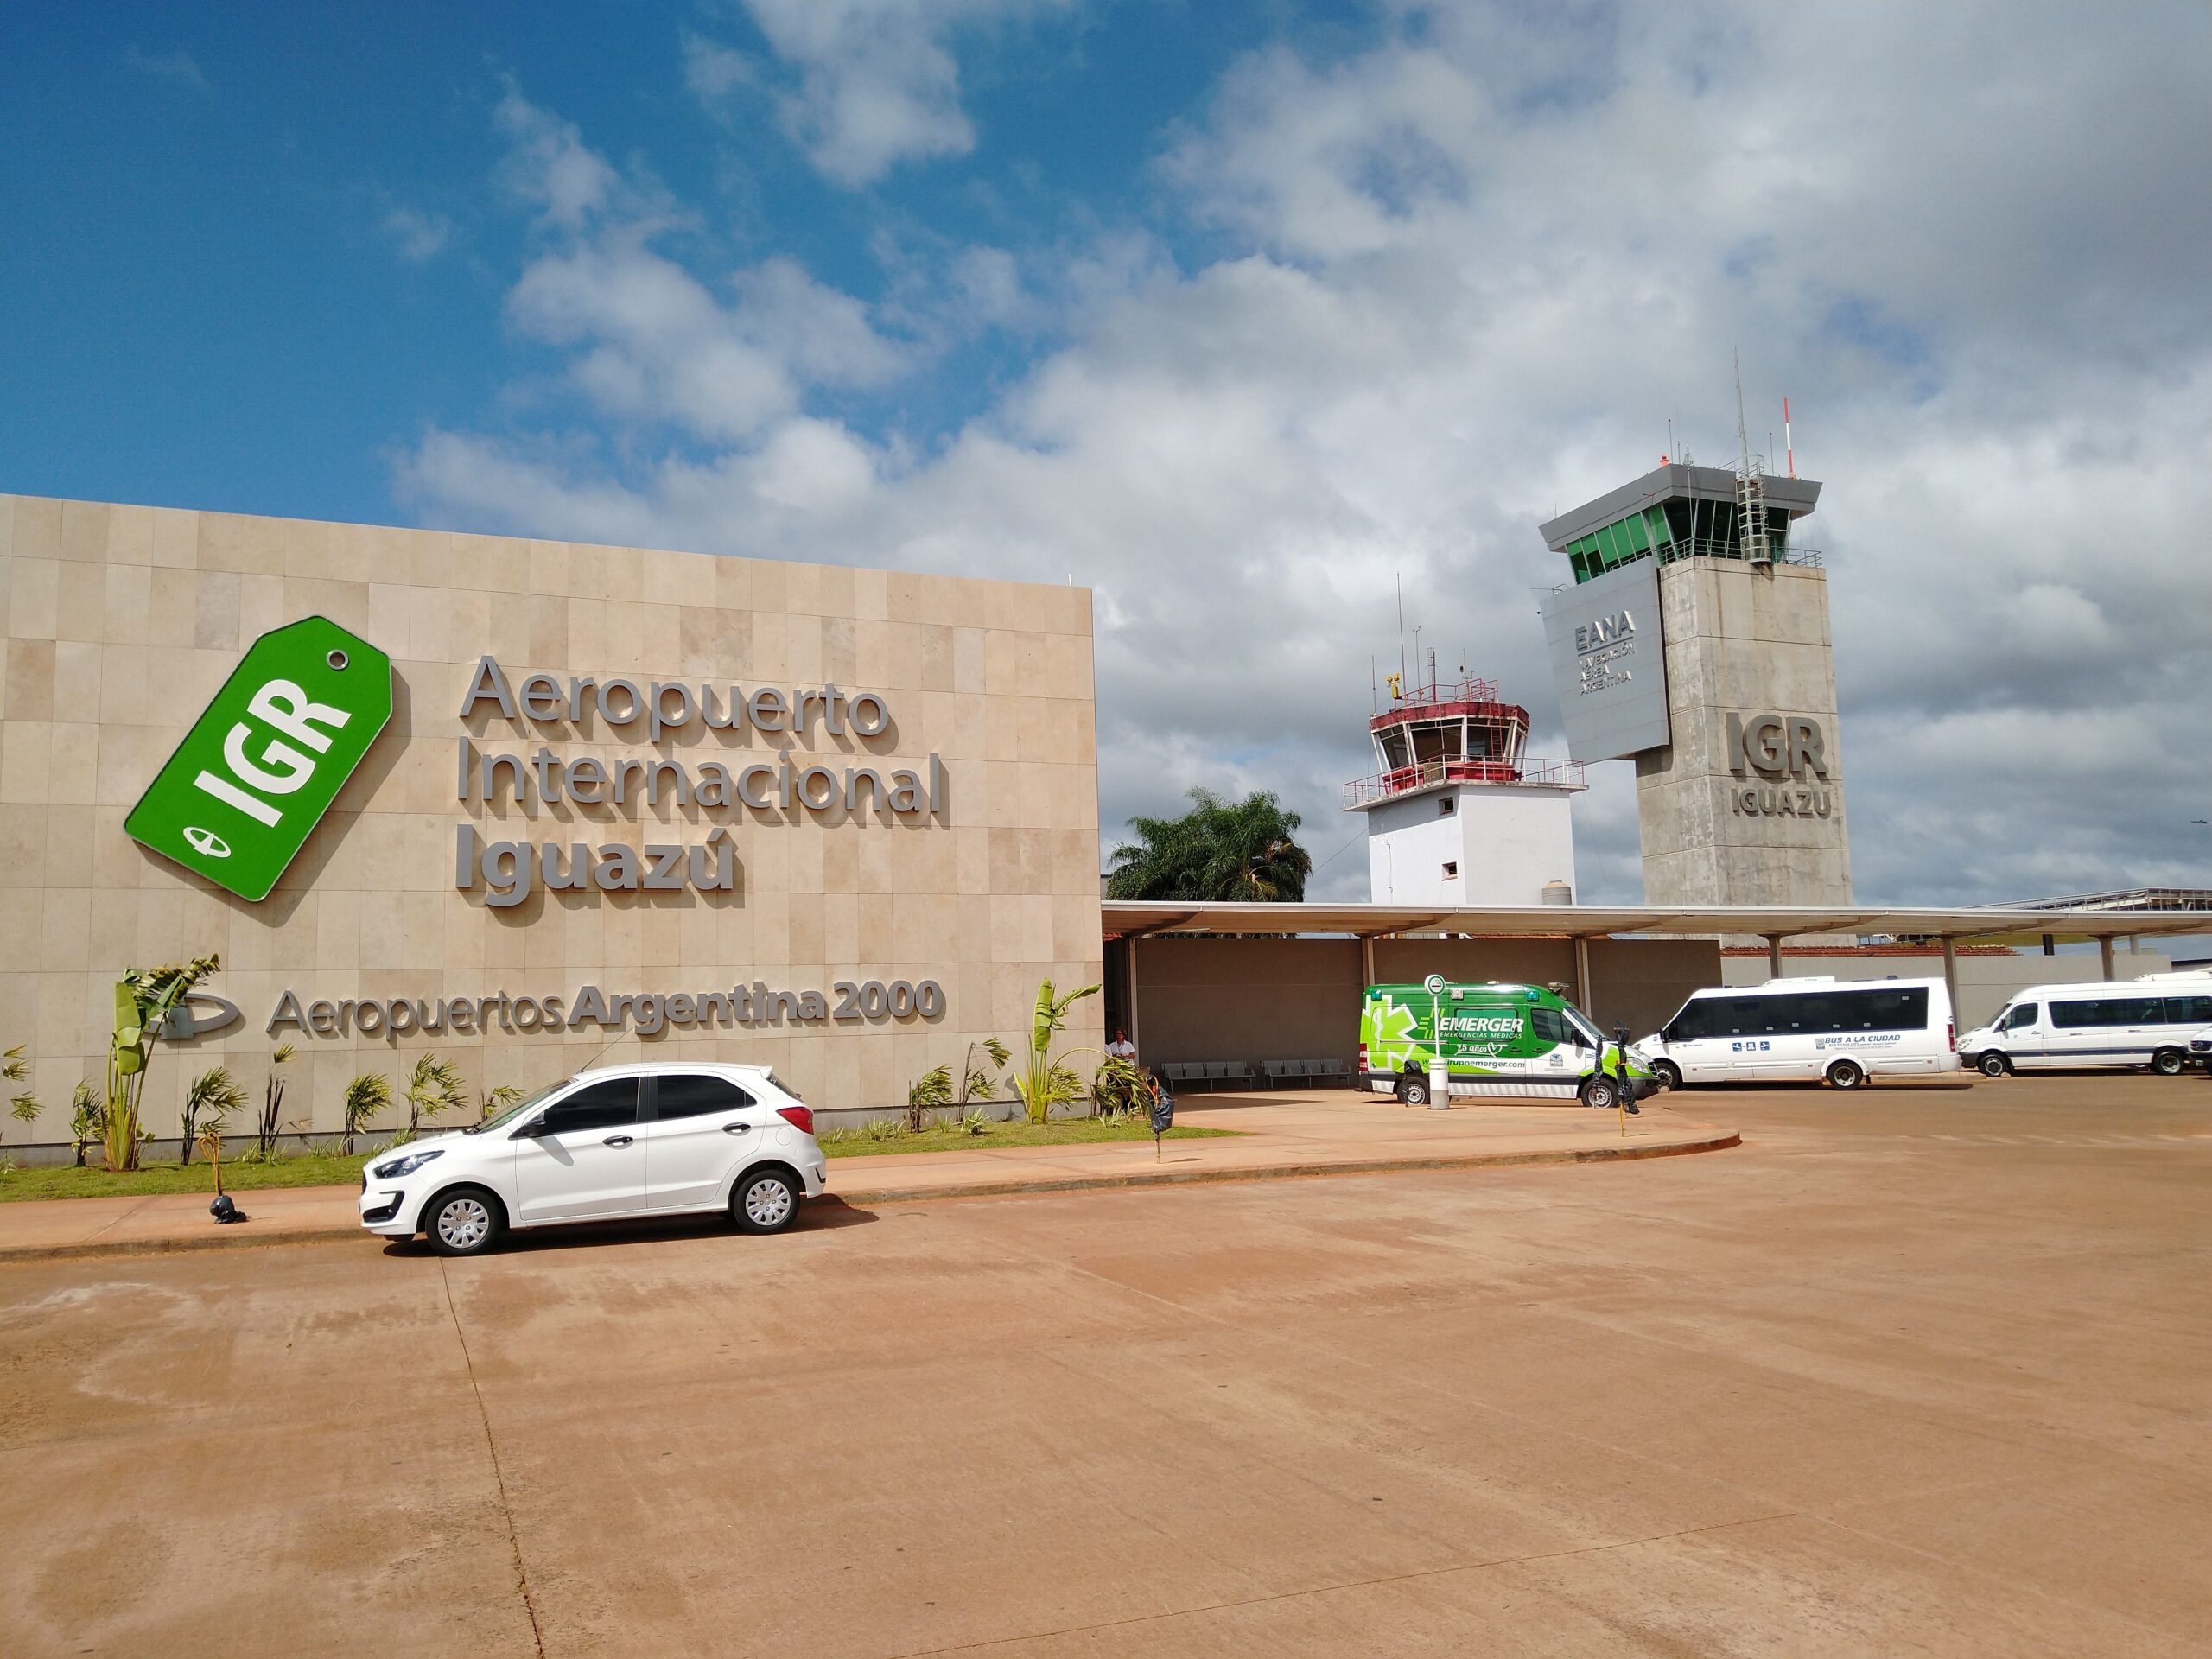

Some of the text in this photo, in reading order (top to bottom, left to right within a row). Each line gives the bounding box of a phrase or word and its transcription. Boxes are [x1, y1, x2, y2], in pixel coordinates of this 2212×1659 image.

[1575, 611, 1636, 652] EANA
[459, 655, 888, 742] Aeropuerto
[1580, 671, 1632, 696] ARGENTINA
[194, 679, 352, 828] IGR
[1726, 712, 1829, 774] IGR
[458, 736, 940, 813] Internacional
[1731, 788, 1831, 816] IGUAZU
[455, 824, 734, 906] Iguazú
[265, 980, 942, 1041] Aeropuertos Argentina 2000
[1439, 1017, 1524, 1032] EMERGER
